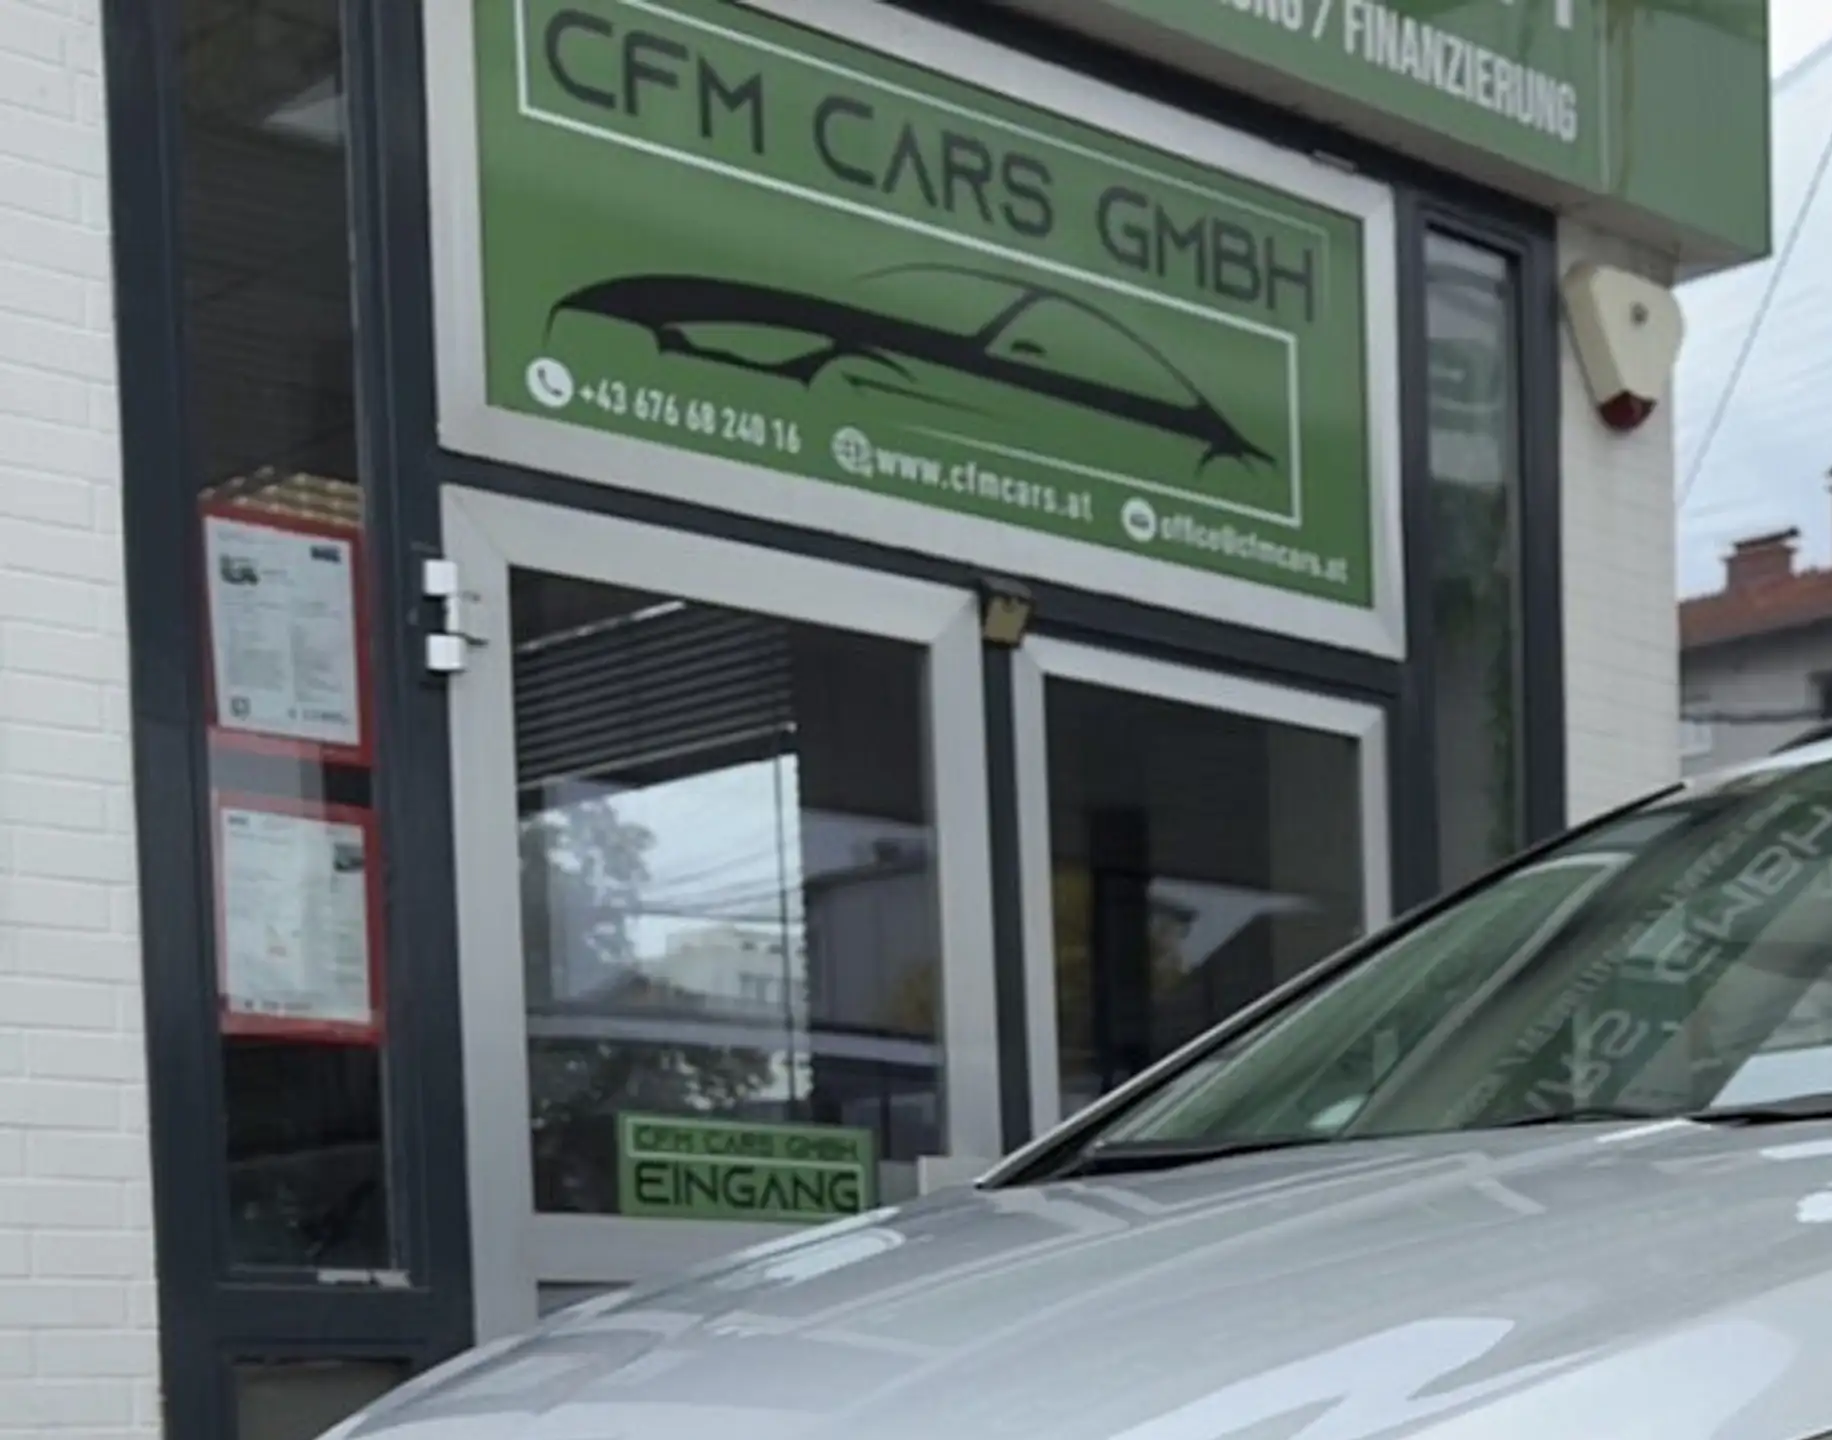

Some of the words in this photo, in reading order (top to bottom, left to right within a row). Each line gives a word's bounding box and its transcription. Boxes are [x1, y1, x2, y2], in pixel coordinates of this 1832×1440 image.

[1343, 0, 1577, 142] FINANZIERUNG
[544, 7, 765, 156] CFM
[813, 95, 1054, 238] CARS
[1096, 185, 1315, 323] GMBH
[579, 378, 628, 416] +43
[633, 387, 680, 428] 676
[685, 397, 716, 436] 68
[770, 418, 802, 455] 16
[875, 447, 1094, 523] www.cfmcars.at
[634, 1160, 861, 1214] EINGANG
